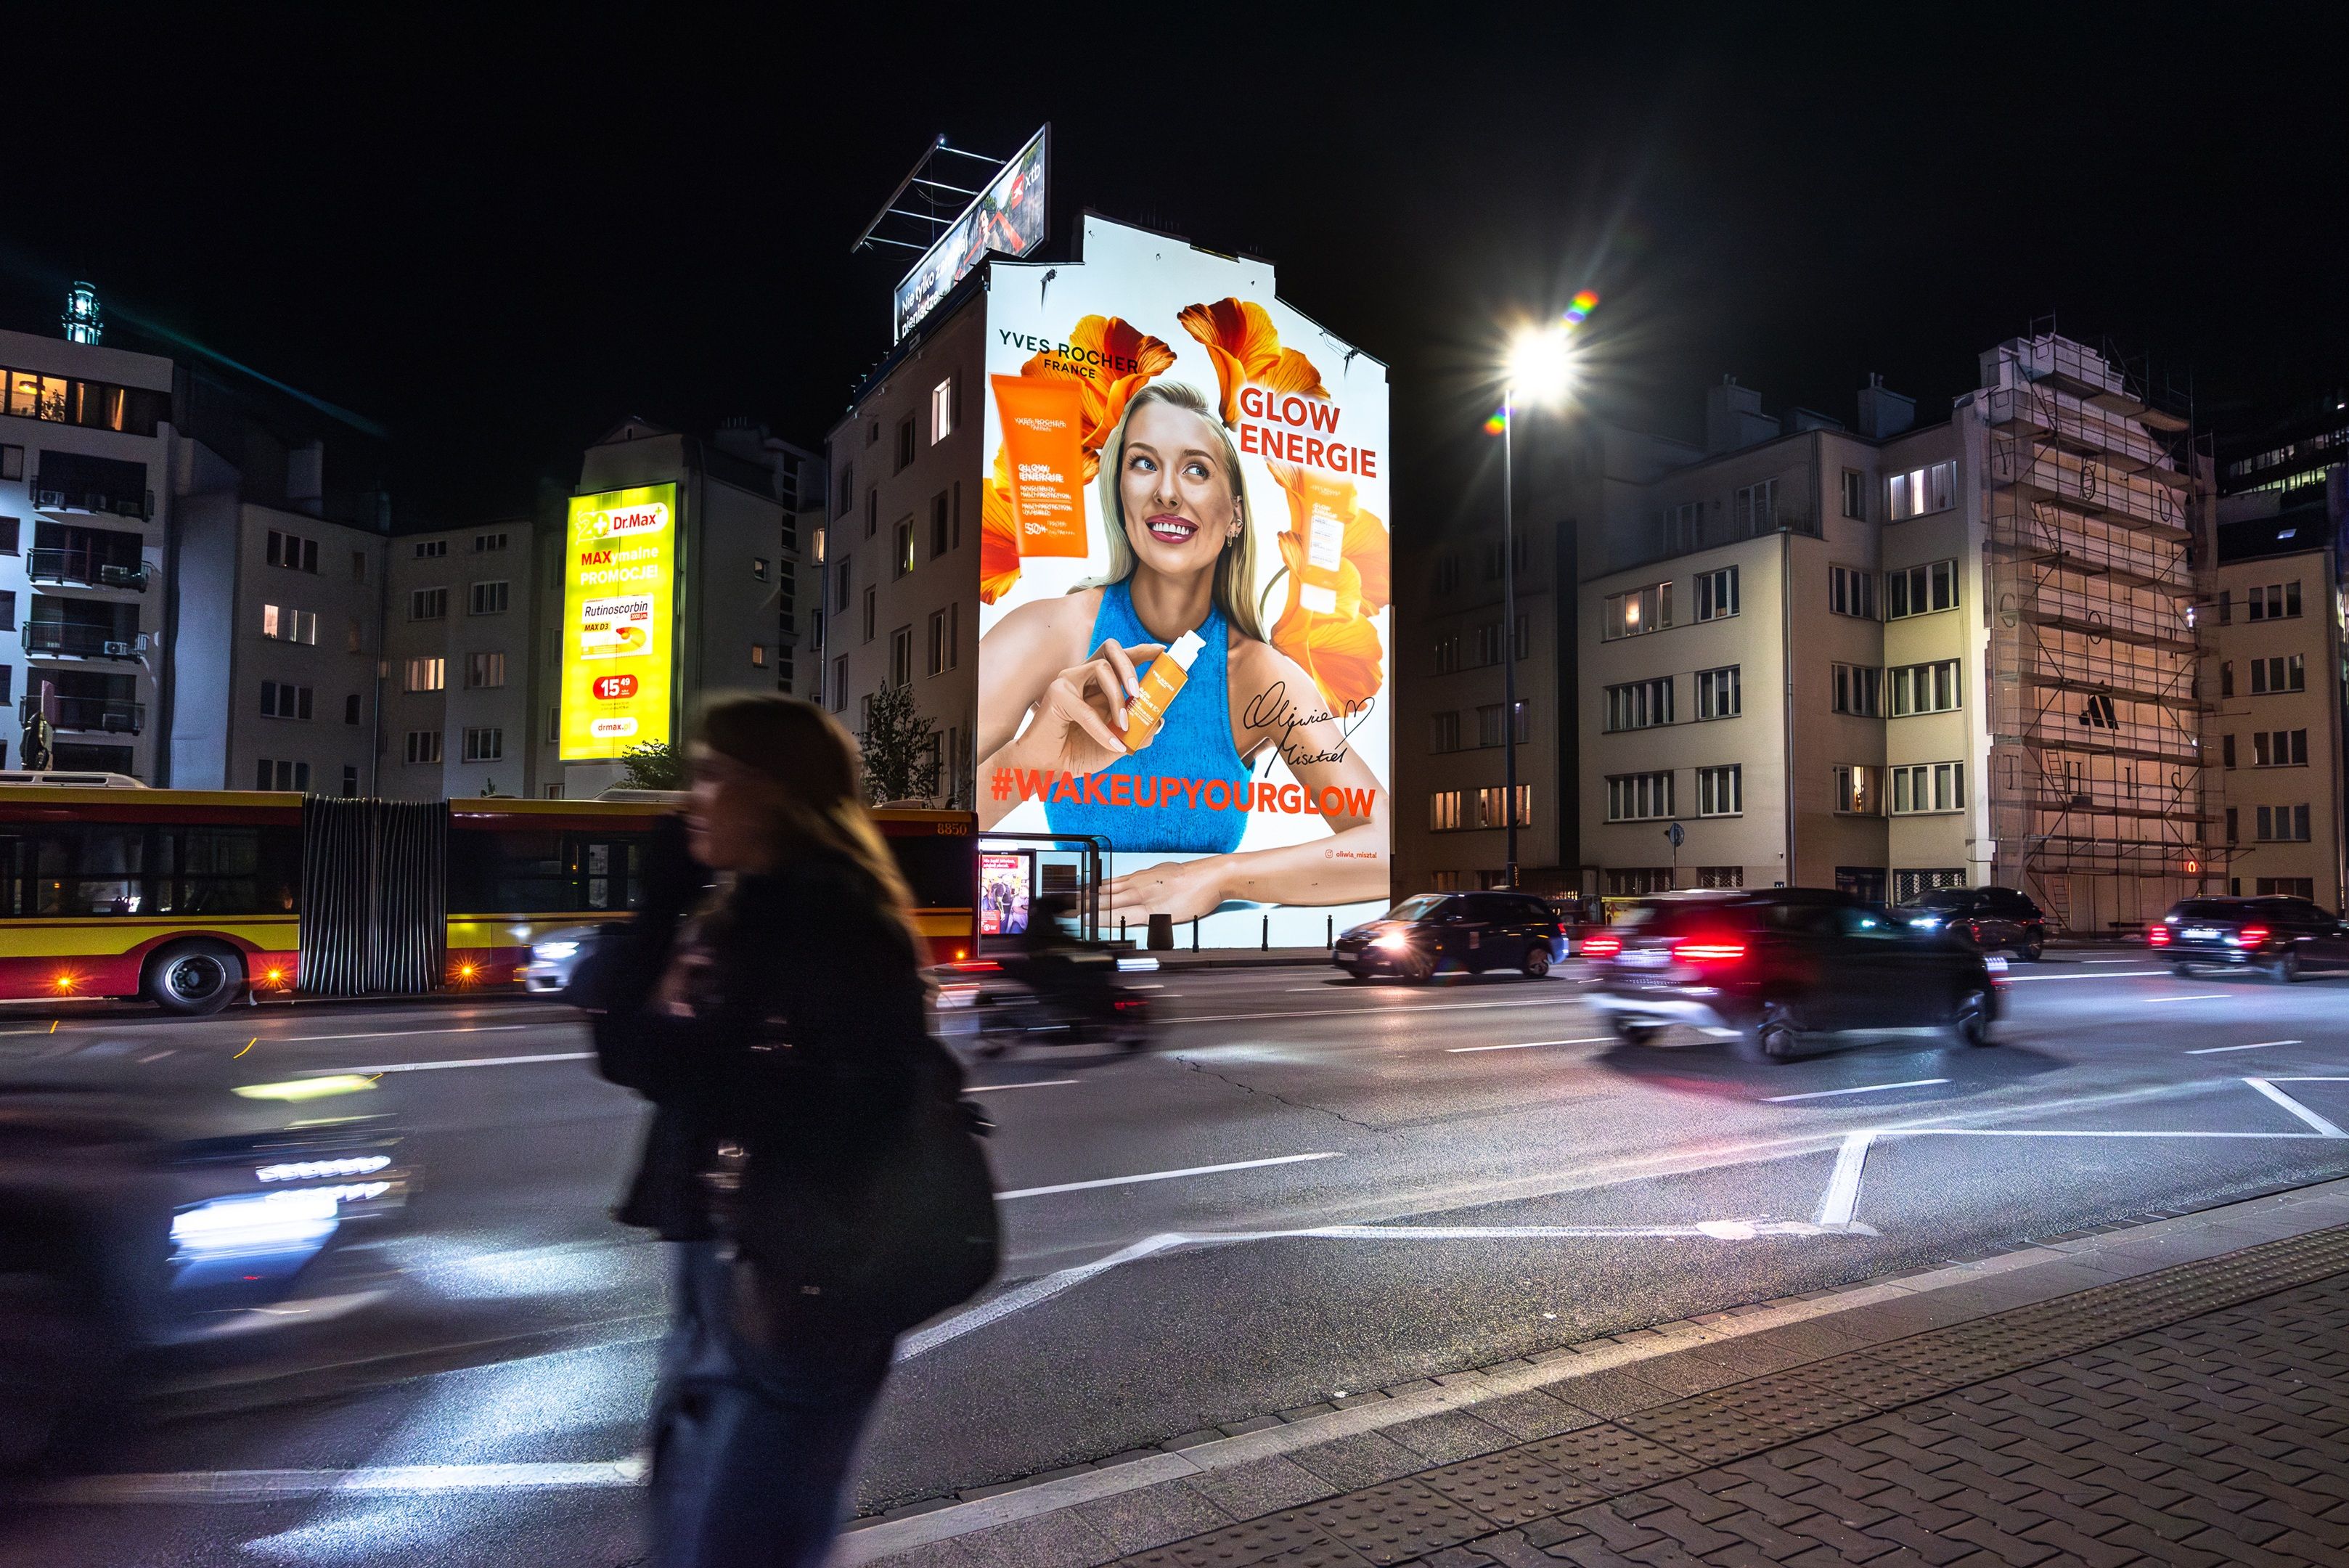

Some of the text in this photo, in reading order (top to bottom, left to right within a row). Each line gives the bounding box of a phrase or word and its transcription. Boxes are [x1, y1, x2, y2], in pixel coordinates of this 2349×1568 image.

[1024, 162, 1041, 189] xtb
[902, 292, 915, 315] Nie
[915, 271, 934, 302] tylko
[999, 329, 1138, 374] YVES ROCHER
[1044, 359, 1095, 378] FRANCE
[1240, 387, 1341, 433] GLOW
[1240, 423, 1377, 478] ENERGIE
[613, 513, 656, 530] Dr.Max
[581, 547, 658, 565] MAXymalne
[580, 564, 658, 586] PROMOCJE!
[585, 601, 648, 616] Rutinoscorbin
[601, 677, 631, 696] 15 49
[991, 767, 1376, 818] #WAKEUPYOURGLOW
[937, 822, 967, 835] 8850
